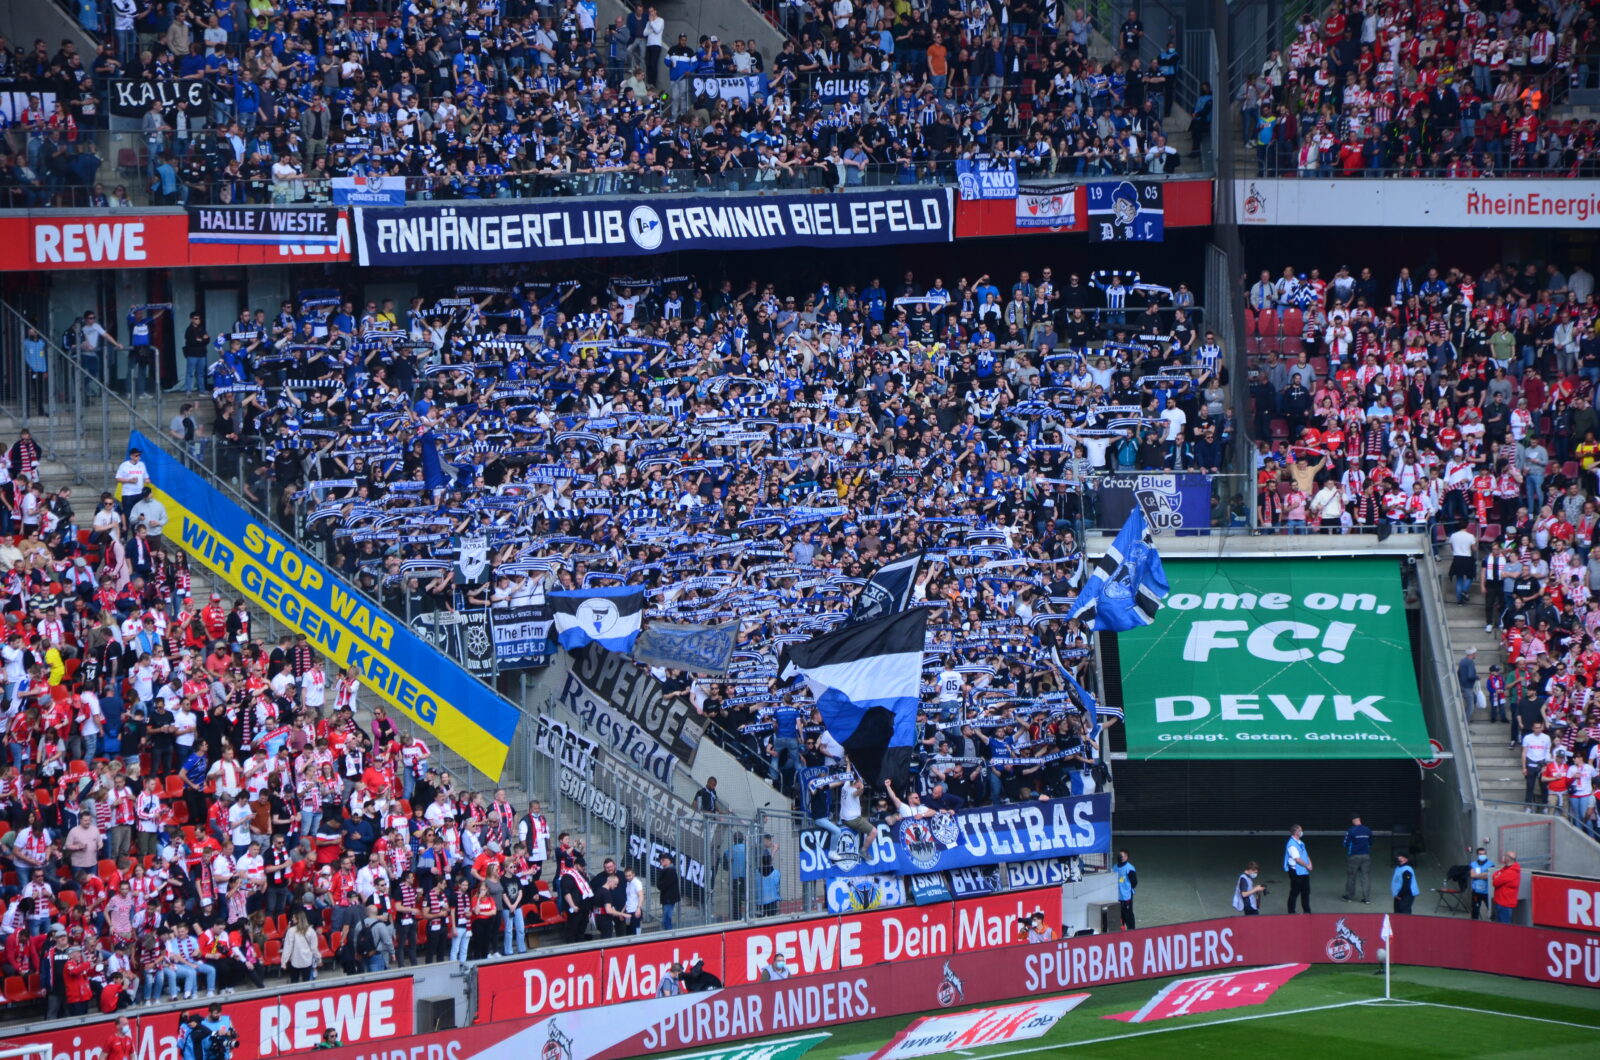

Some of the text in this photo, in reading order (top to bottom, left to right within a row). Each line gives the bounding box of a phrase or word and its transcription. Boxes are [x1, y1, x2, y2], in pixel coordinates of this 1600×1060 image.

[720, 78, 745, 88] PLUS
[979, 172, 1015, 187] ZWO
[982, 187, 1017, 197] BIELEFELD
[1090, 187, 1103, 200] 19
[1144, 186, 1158, 200] 05
[200, 211, 254, 231] HALLE
[270, 212, 329, 233] WESTF.
[377, 208, 626, 253] ANHÄNGERCLUB
[666, 198, 942, 241] ARMINIA BIELEFELD
[35, 222, 147, 264] REWE
[1102, 476, 1139, 491] Crazy
[1141, 476, 1173, 488] Blue
[954, 566, 993, 576] RUN DSC
[244, 522, 394, 651] STOP WAR
[1157, 592, 1392, 615] ome on,
[181, 516, 438, 727] WIR GEGEN KRIEG
[497, 625, 544, 640] The Firm
[497, 642, 545, 656] BIELEFELD
[1183, 620, 1357, 664] FC!
[581, 643, 689, 746] SPENGE
[946, 681, 958, 691] 05
[1155, 694, 1393, 723] DEVK
[558, 671, 676, 784] Raesfeld
[1157, 732, 1397, 743] Gesagt. Getan. Geholfen.
[957, 800, 1096, 858] ULTRAS
[953, 868, 985, 892] 647
[1009, 860, 1062, 887] BOYS
[746, 922, 863, 982] REWE
[881, 914, 947, 961] Dein
[1025, 928, 1243, 992] SPÜRBAR ANDERS.
[523, 963, 595, 1014] Dein
[772, 978, 876, 1031] ANDERS.
[260, 988, 396, 1057] REWE
